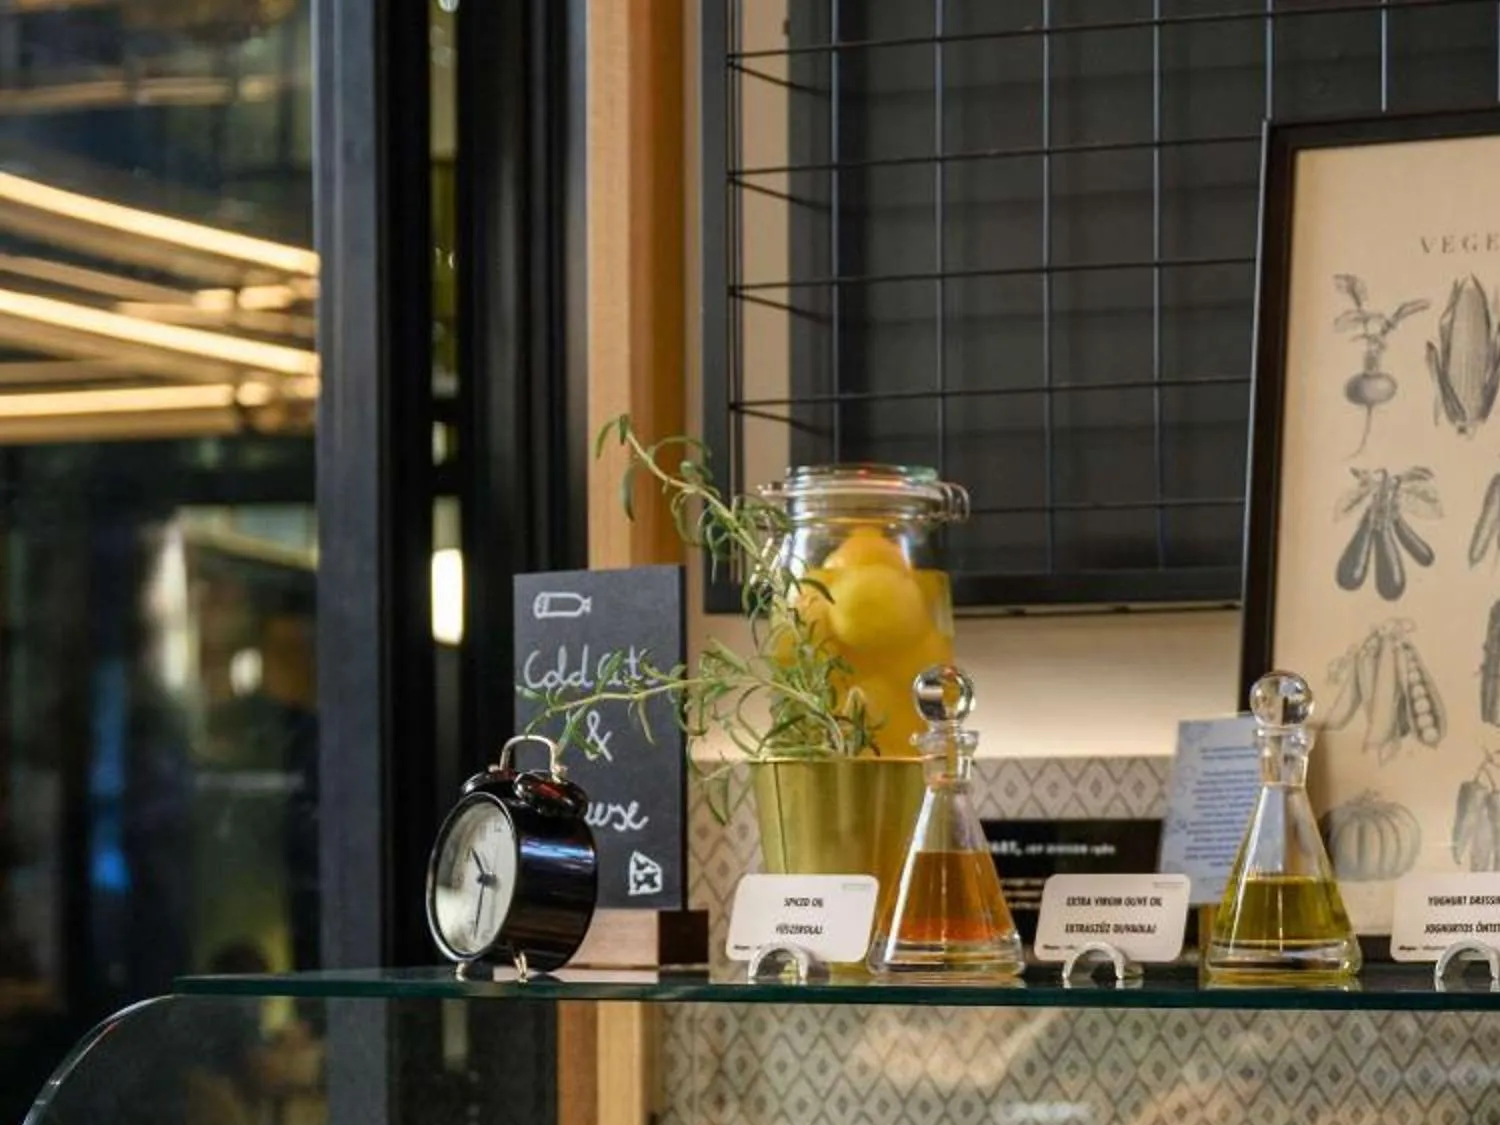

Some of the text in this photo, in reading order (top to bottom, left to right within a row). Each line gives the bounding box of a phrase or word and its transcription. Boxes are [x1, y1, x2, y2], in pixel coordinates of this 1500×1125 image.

[523, 643, 594, 688] Cold
[584, 710, 614, 762] &
[1428, 895, 1467, 907] YOGHURT
